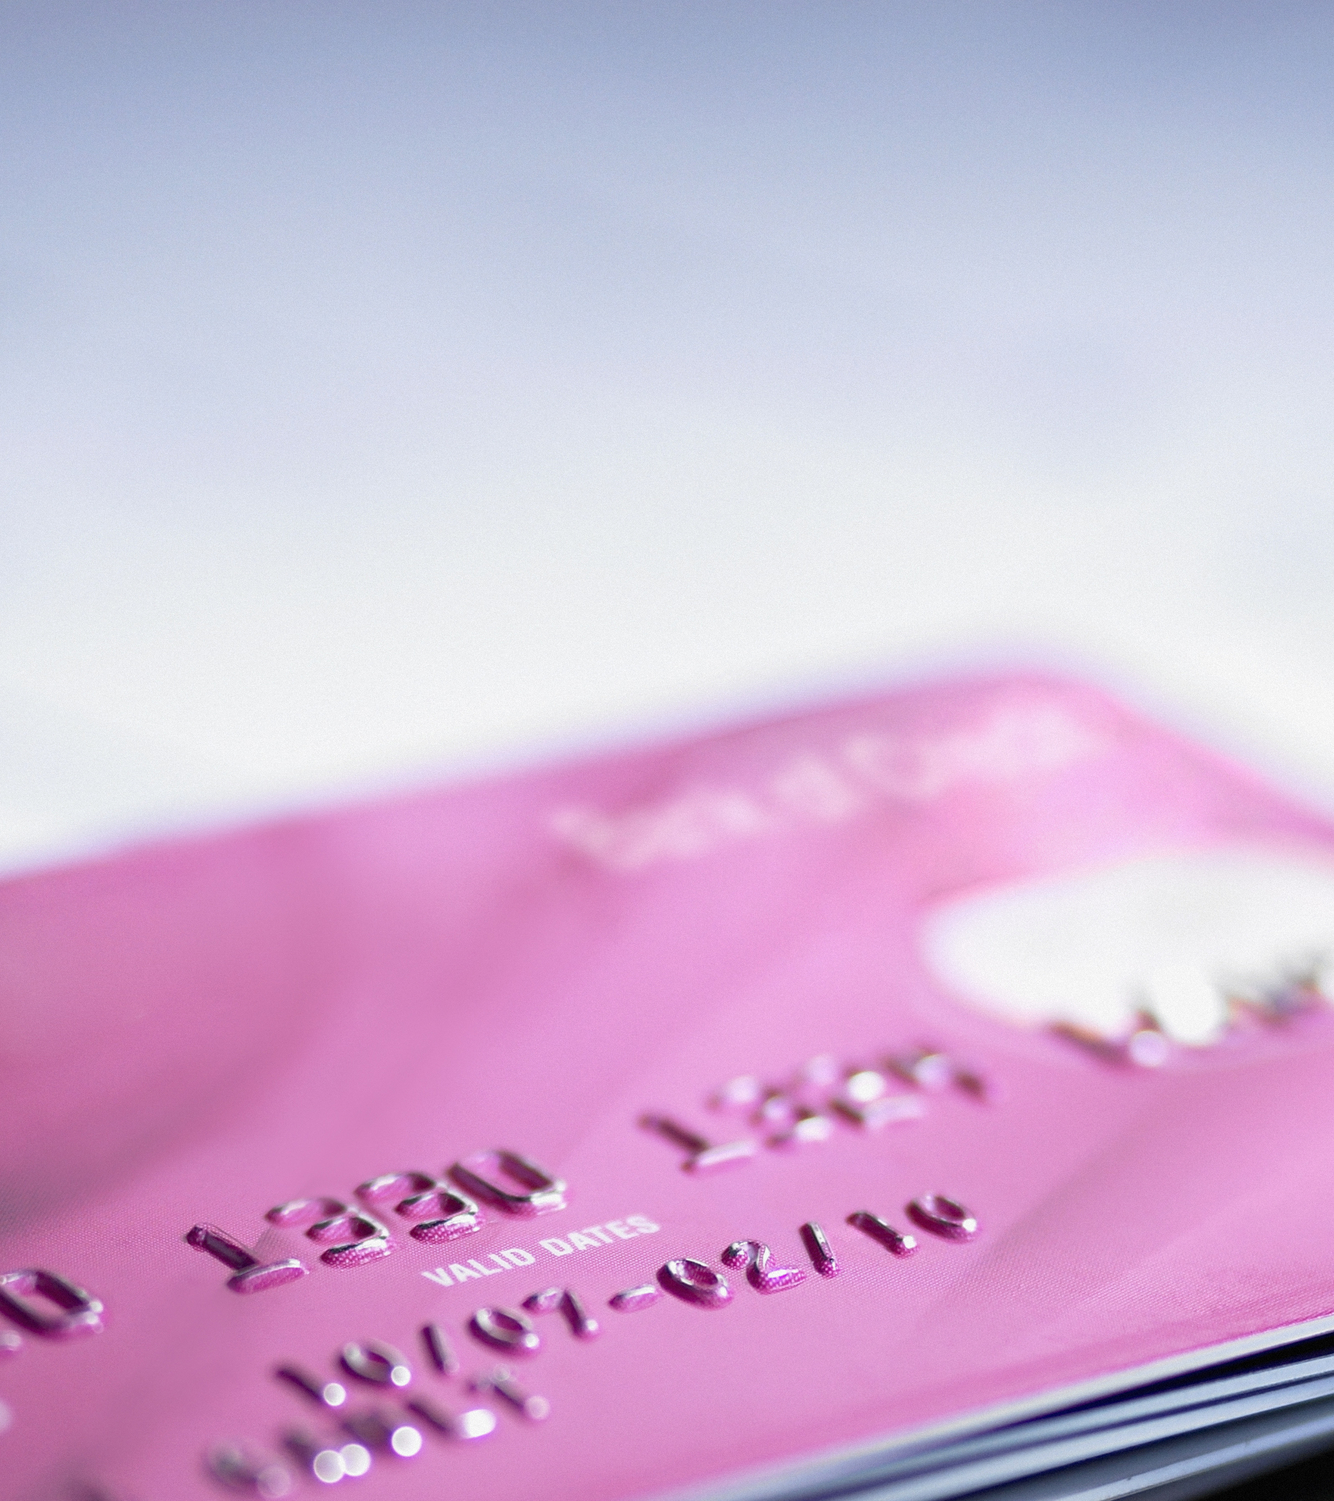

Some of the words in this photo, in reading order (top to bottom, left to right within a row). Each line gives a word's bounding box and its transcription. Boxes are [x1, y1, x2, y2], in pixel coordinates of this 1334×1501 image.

[184, 1146, 568, 1294] 1330
[421, 1245, 536, 1290] VALID
[546, 1214, 662, 1259] DATES
